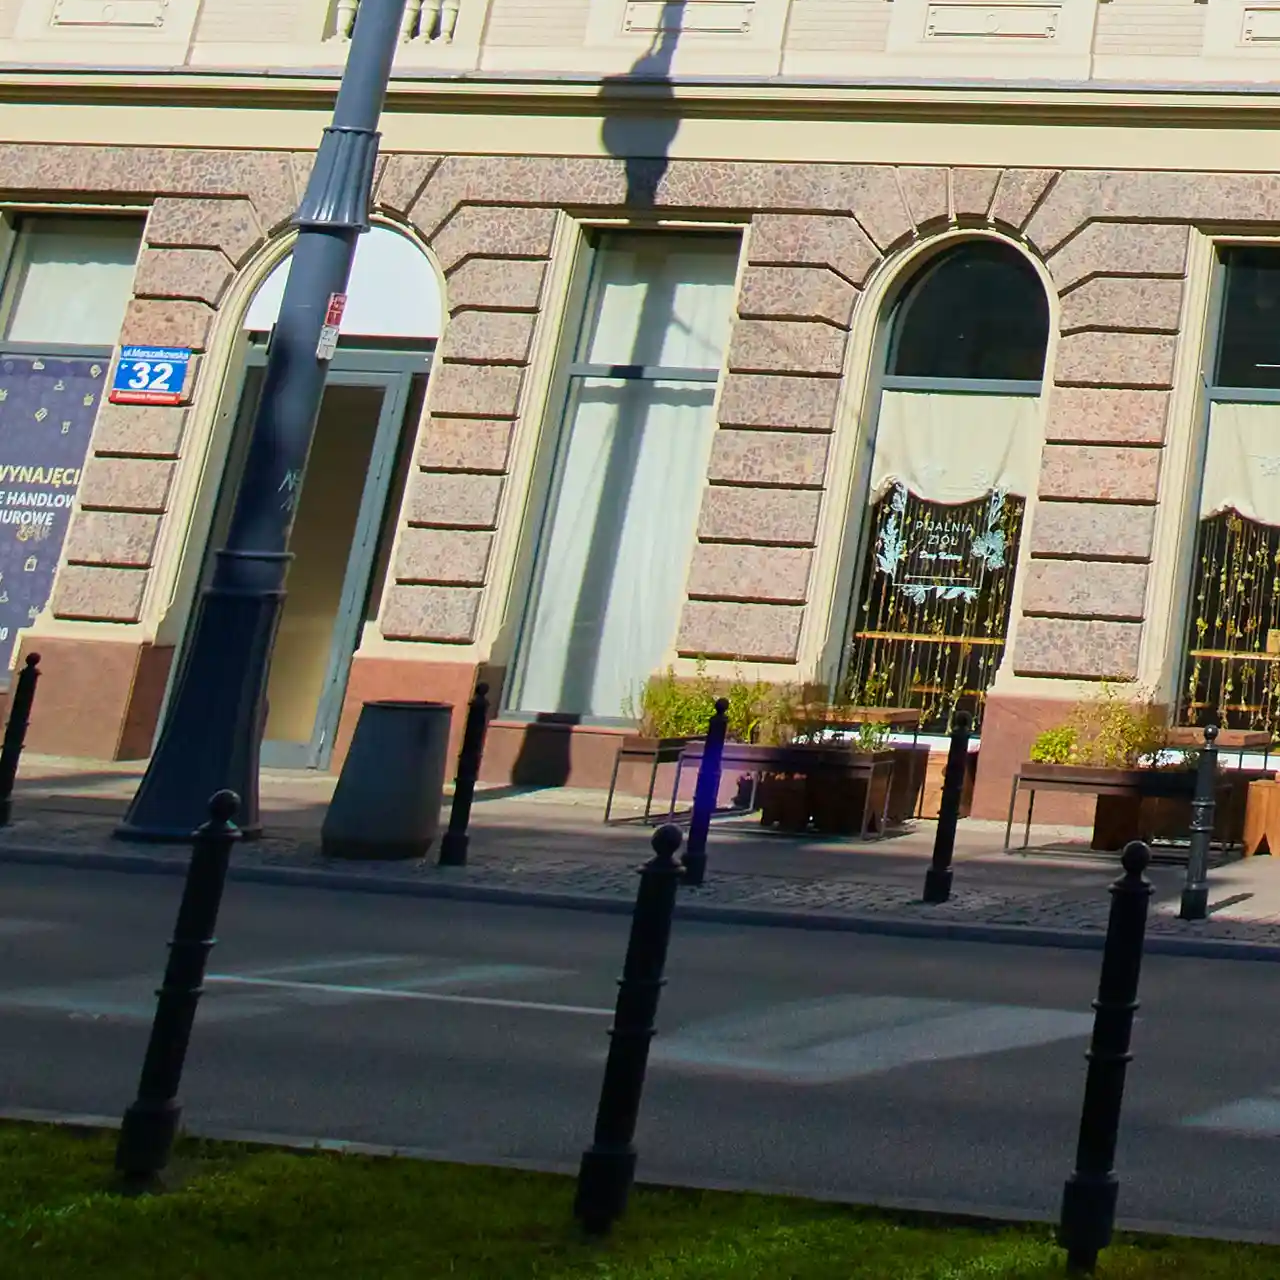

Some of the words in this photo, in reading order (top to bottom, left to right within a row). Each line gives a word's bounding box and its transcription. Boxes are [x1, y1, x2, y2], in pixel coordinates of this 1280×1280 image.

[128, 362, 173, 390] 32
[0, 464, 80, 488] WYNAJĘCI
[6, 491, 77, 508] HANDLOW
[0, 509, 55, 526] IUROWE
